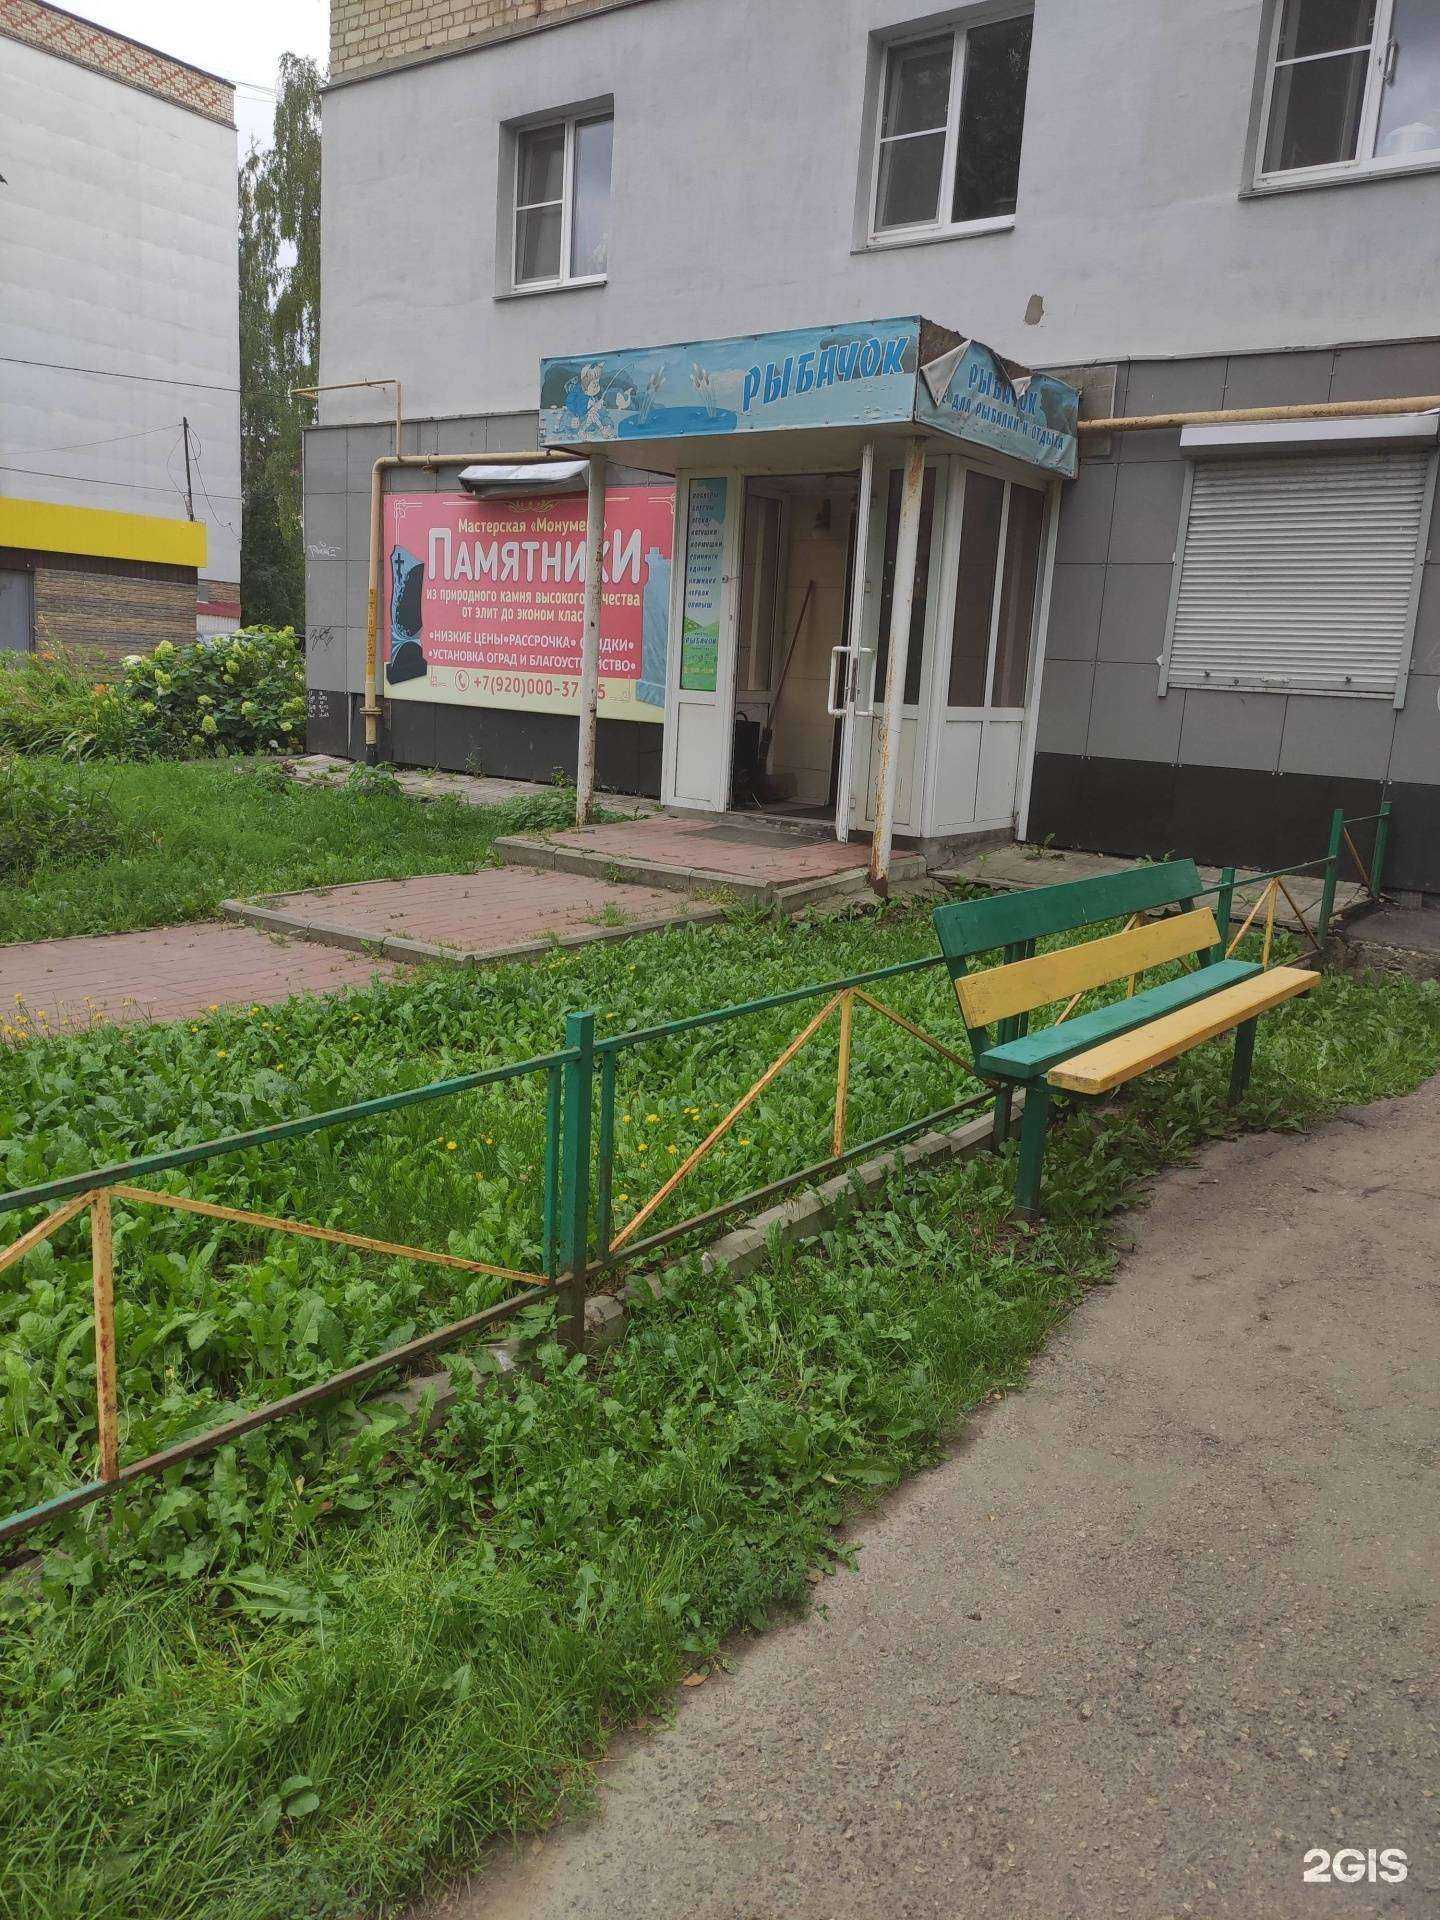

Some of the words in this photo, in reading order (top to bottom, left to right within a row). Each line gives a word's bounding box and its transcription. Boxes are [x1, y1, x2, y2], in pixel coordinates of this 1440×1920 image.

[743, 336, 910, 415] РЫБАЧОК
[968, 363, 1038, 416] РЫБАОК
[951, 393, 972, 414] ДЛЯ
[975, 400, 1020, 432] РЫБАЛКИ
[1032, 426, 1065, 451] ОТДЫХА
[458, 517, 526, 537] Мастерская
[530, 516, 608, 537] «Монуме»
[426, 588, 437, 600] из
[440, 588, 497, 605] природного
[500, 590, 532, 604] камня
[535, 591, 585, 605] высокого
[462, 607, 473, 618] от
[475, 607, 499, 619] элит
[501, 608, 514, 622] до
[516, 608, 554, 621] эконом
[434, 630, 472, 644] НИЗКИЕ
[474, 633, 503, 646] ЦЕНЫ
[509, 634, 571, 649] РАССРОЧКА
[579, 637, 628, 653] СДКИ
[432, 649, 485, 663] УСТАНОВКА
[486, 653, 518, 666] ОГРАД
[519, 654, 527, 665] И
[529, 655, 630, 672] БЛАГОУСТСТВО
[474, 675, 606, 700] +7(920)000-375
